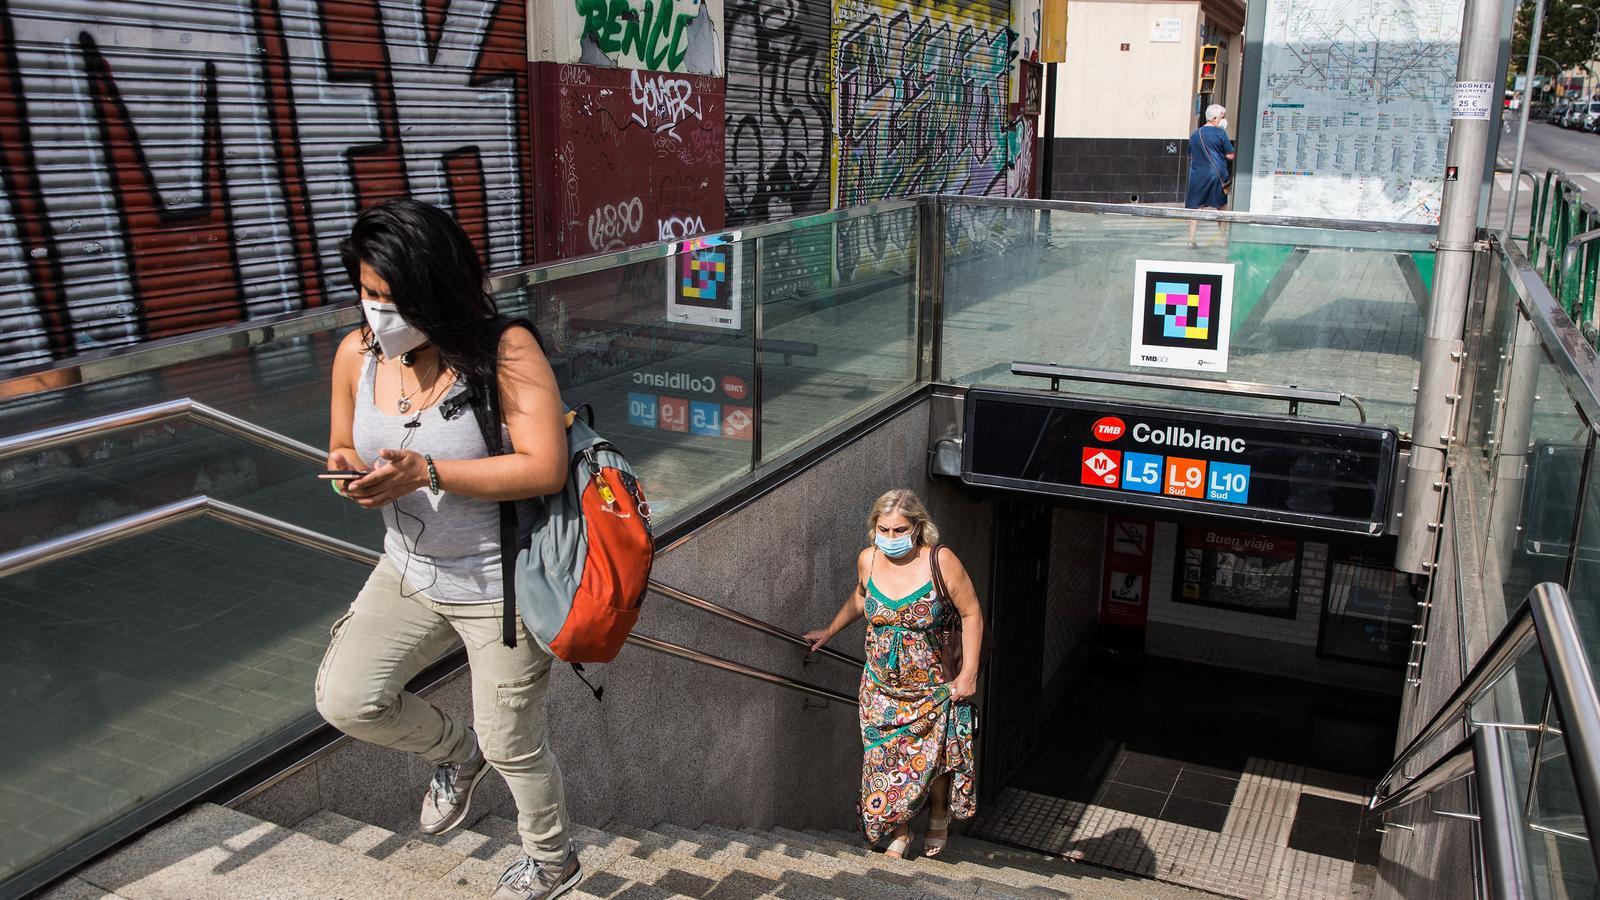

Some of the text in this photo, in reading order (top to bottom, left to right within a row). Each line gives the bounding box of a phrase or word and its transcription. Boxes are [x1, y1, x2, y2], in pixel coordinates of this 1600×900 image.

[1098, 422, 1246, 454] TMB Collblanc
[1094, 458, 1247, 493] M L5 L9 L10
[1168, 486, 1228, 500] Sud Sud
[1205, 532, 1275, 551] Buen viaje
